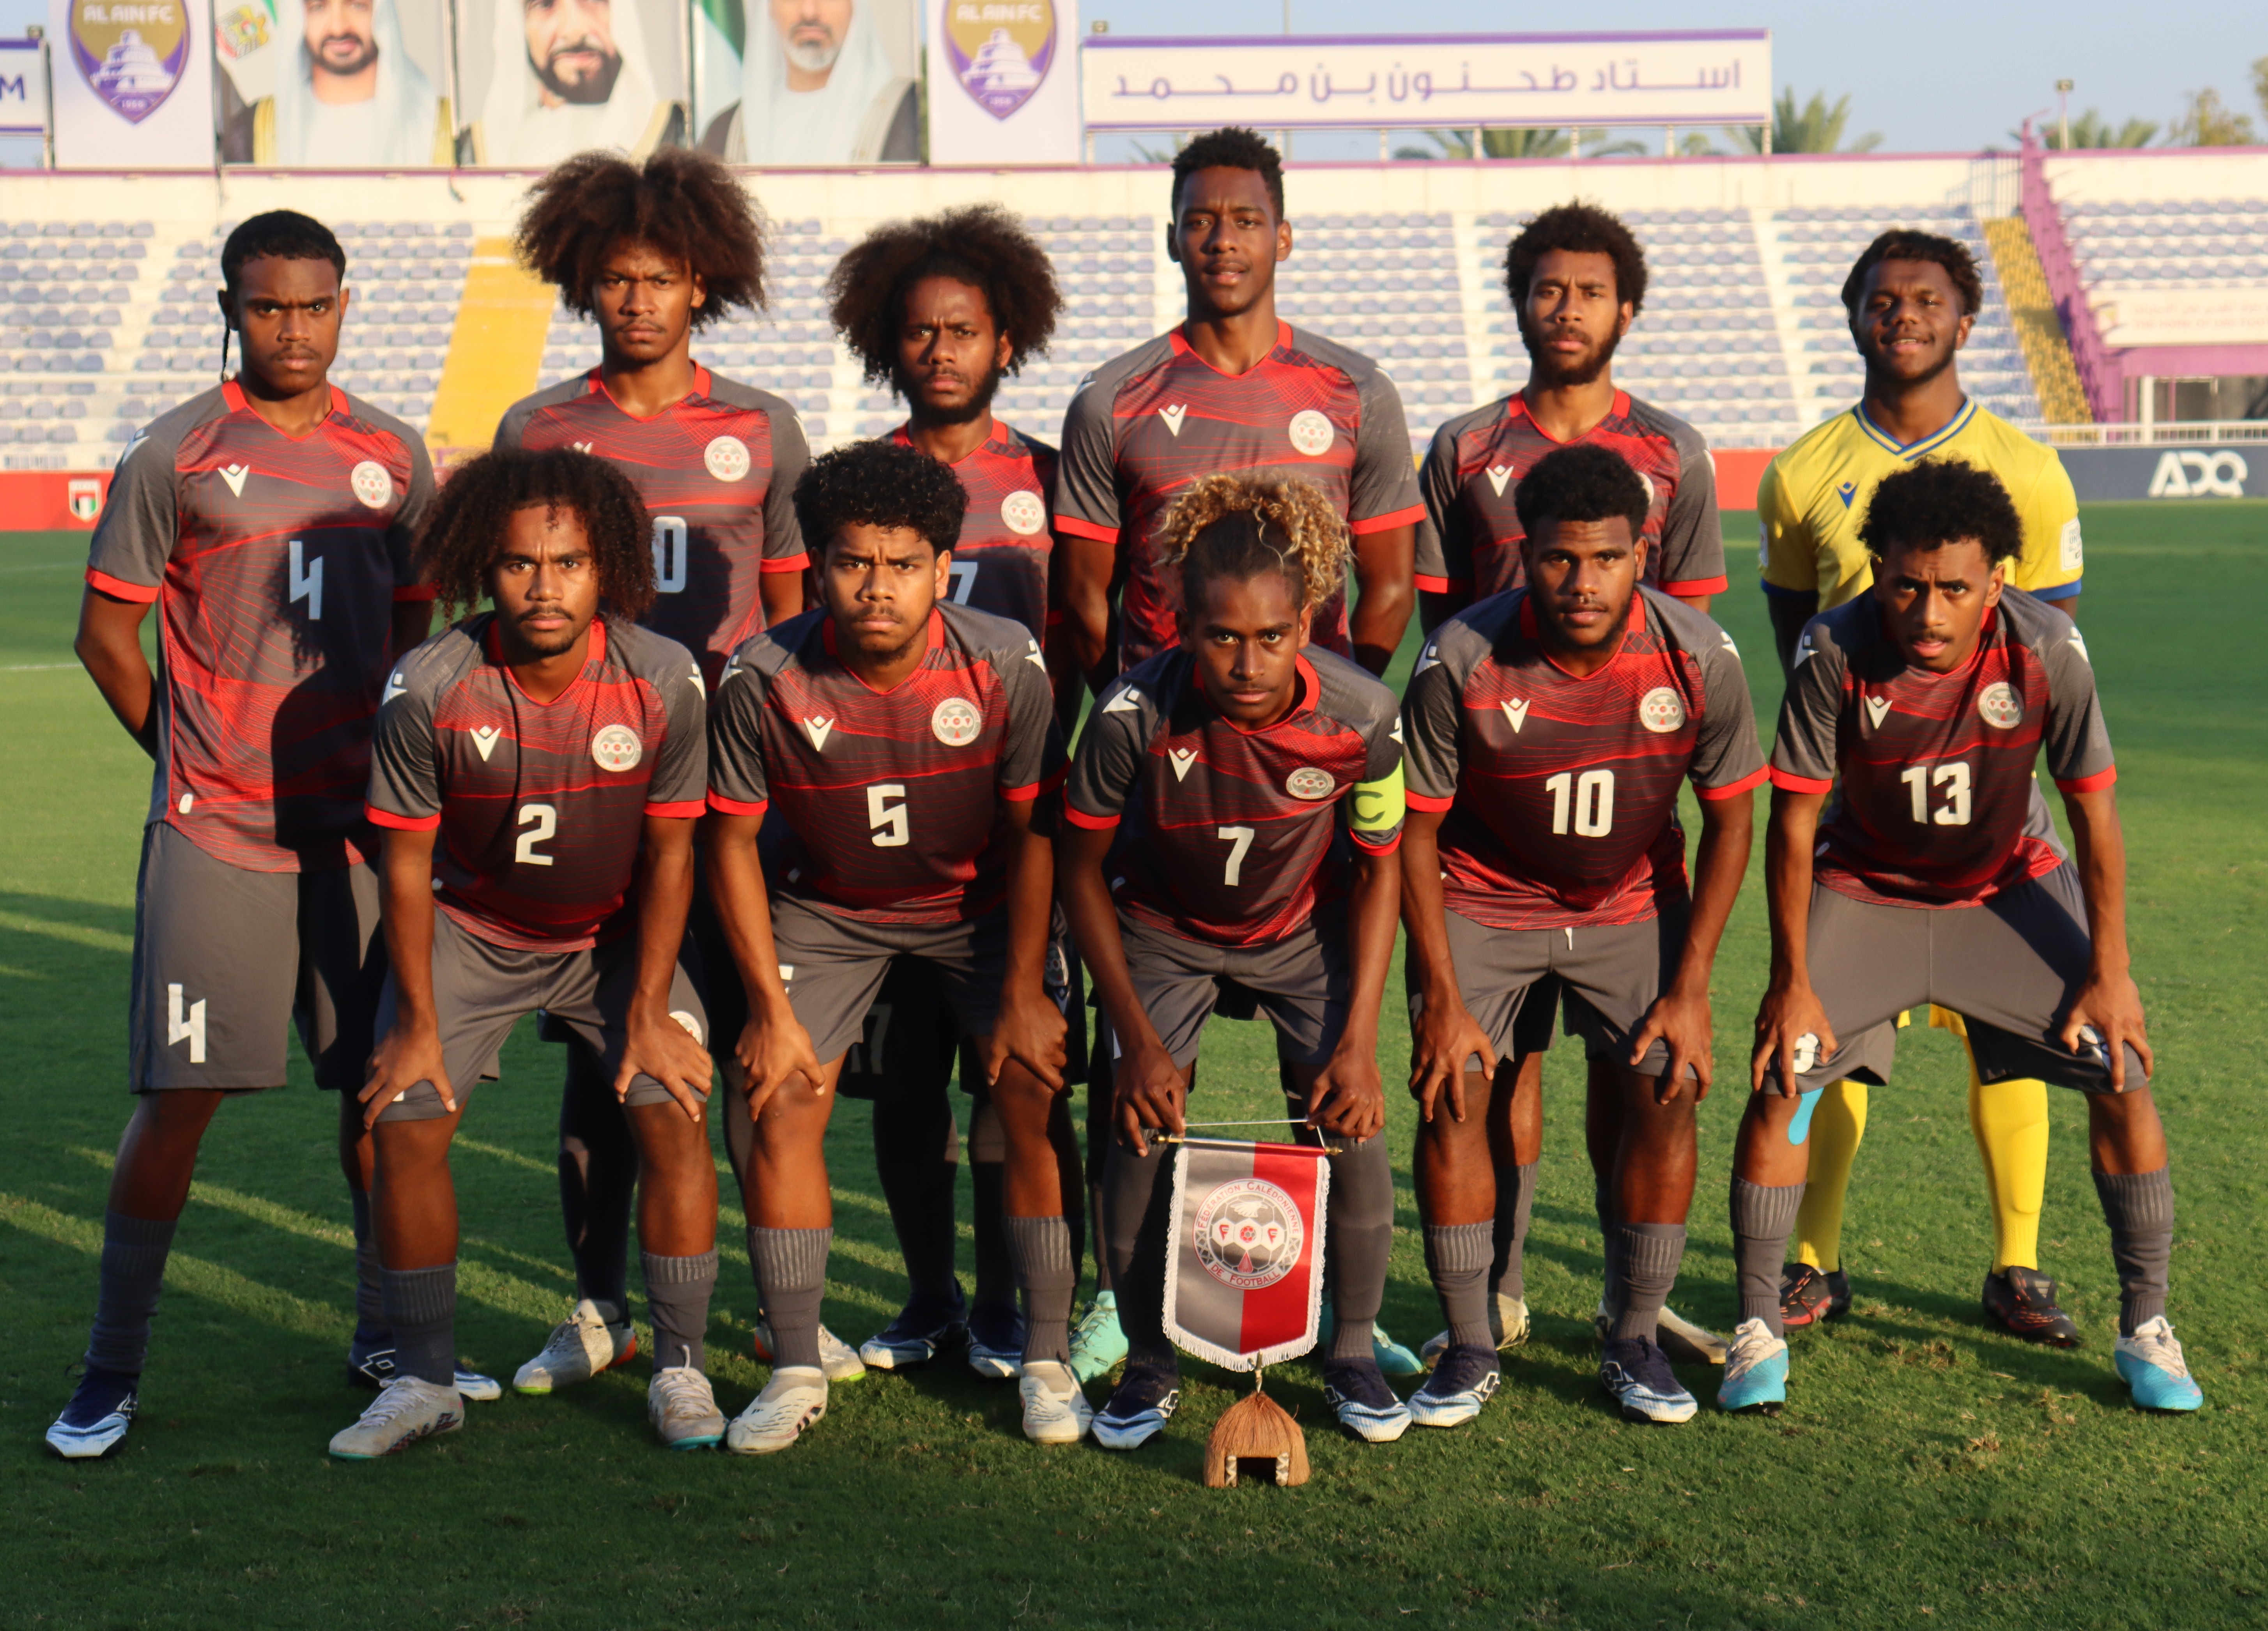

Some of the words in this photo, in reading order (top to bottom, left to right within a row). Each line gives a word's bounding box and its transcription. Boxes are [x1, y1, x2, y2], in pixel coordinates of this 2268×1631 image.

[83, 5, 109, 23] AL
[111, 5, 146, 23] AIN
[148, 5, 174, 23] FC
[957, 4, 981, 21] AL
[983, 4, 1016, 21] AIN
[1018, 4, 1042, 22] FC
[1111, 72, 1299, 101] محمد
[1310, 62, 1377, 104] بن
[2148, 450, 2248, 498] ADQ
[289, 541, 323, 620] 4
[652, 516, 687, 593] 0
[949, 562, 978, 605] 7
[867, 784, 910, 847] 5
[1352, 791, 1385, 823] C
[1546, 770, 1615, 837] 10
[1901, 761, 1971, 825] 13
[515, 804, 557, 866] 2
[1218, 826, 1255, 886] 7
[168, 983, 206, 1063] 4
[1198, 1184, 1241, 1229] FÉDÉRATION
[1247, 1182, 1299, 1234] CALÉDONIENNE
[1211, 1264, 1225, 1278] DE
[1229, 1271, 1281, 1287] FOOTBALL
